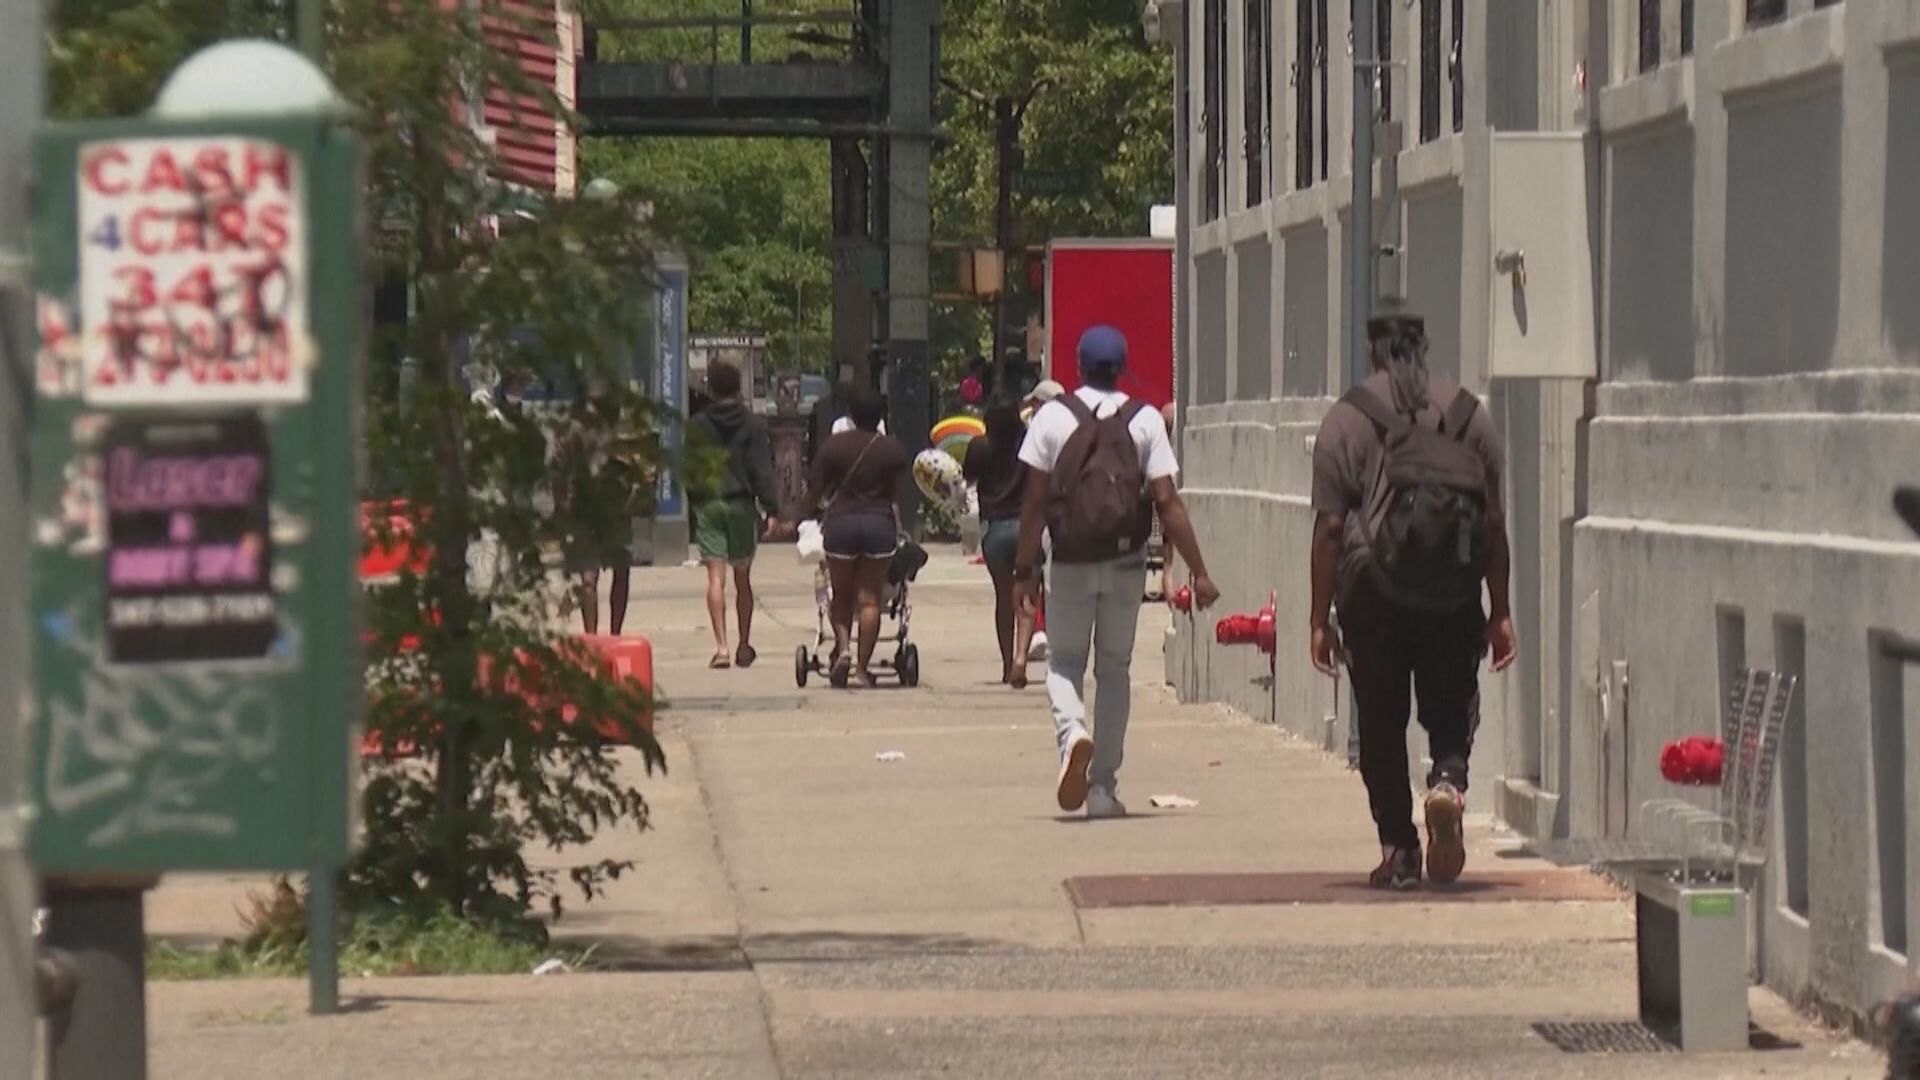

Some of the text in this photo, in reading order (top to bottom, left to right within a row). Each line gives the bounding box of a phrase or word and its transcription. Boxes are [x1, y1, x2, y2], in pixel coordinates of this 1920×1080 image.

[85, 145, 290, 196] CASH
[90, 203, 289, 256] 4 CARS
[694, 335, 750, 348] BROWNSVILLE
